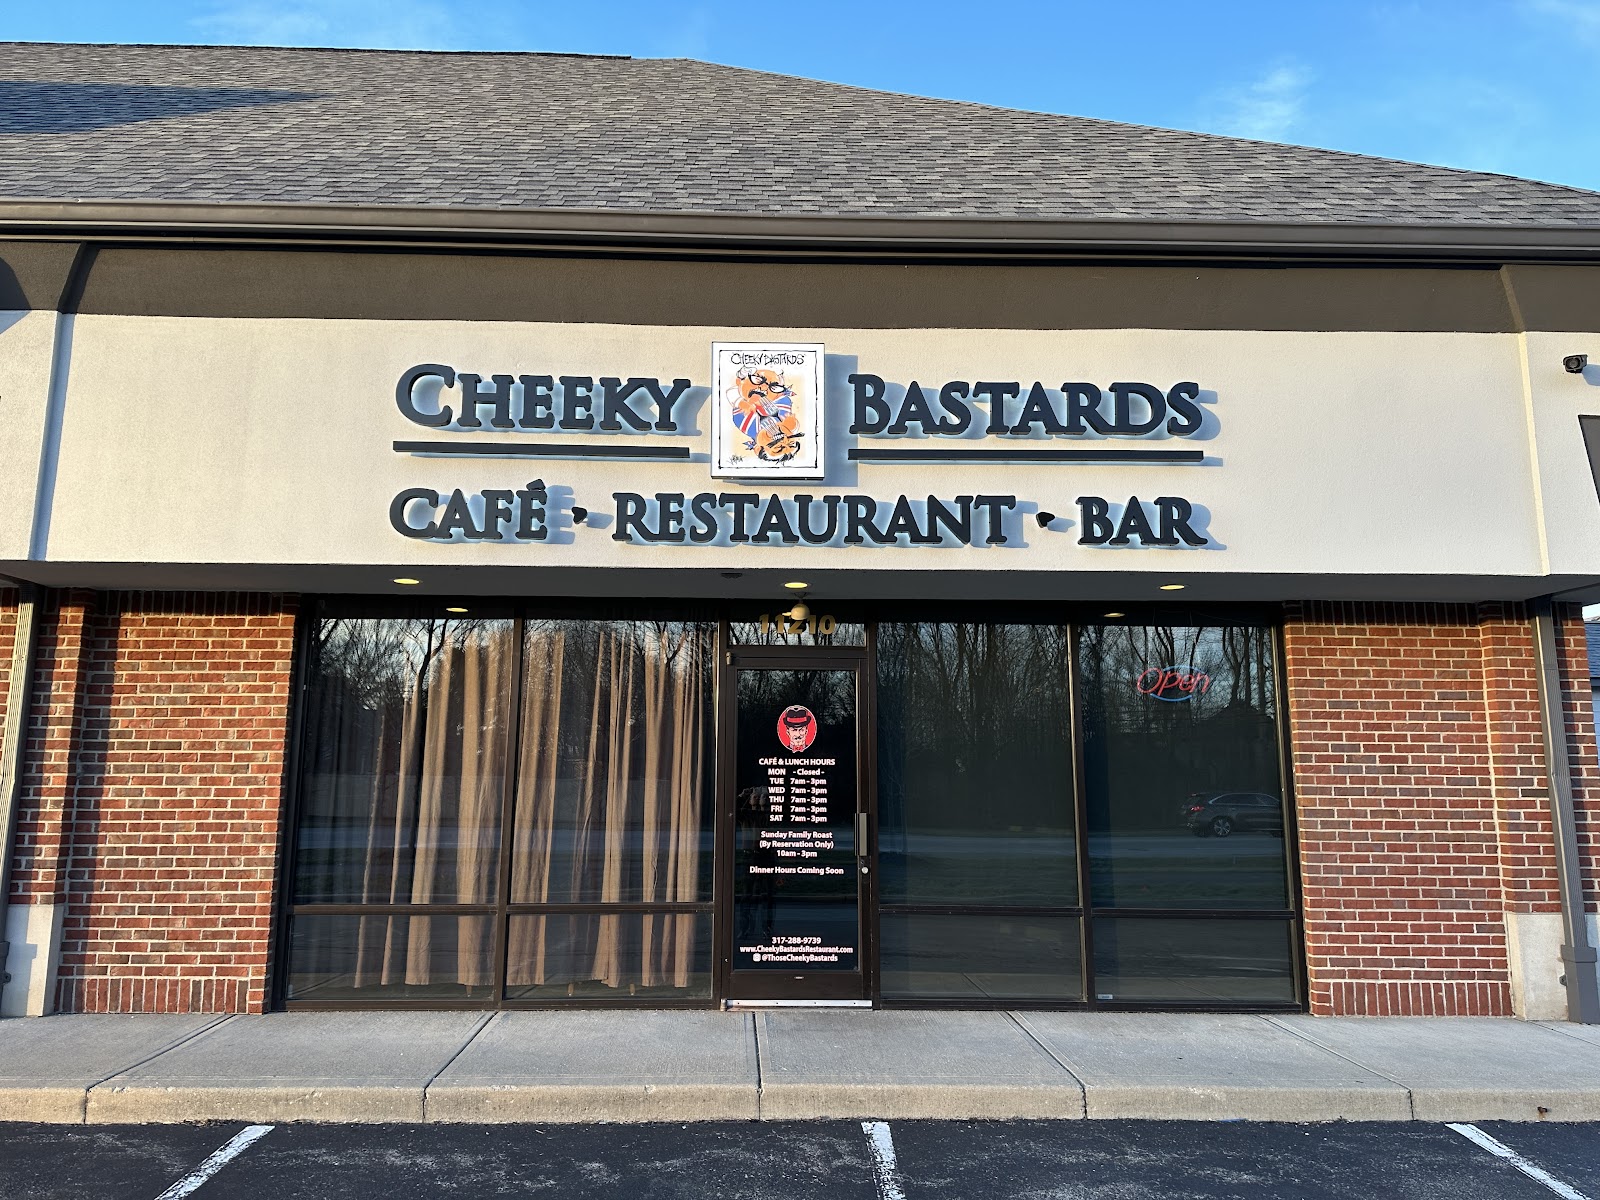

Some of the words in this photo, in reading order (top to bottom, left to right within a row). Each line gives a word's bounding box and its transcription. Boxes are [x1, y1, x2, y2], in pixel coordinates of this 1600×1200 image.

[731, 353, 763, 365] CHEEKY
[395, 363, 692, 432] CHEEKY
[848, 374, 1203, 436] BASTARDS
[389, 478, 548, 540] CAFÉ
[611, 492, 1017, 545] RESTAURANT
[1075, 496, 1209, 546] BAR
[759, 614, 836, 635] 11210
[1136, 667, 1211, 696] Open
[758, 757, 778, 766] CAFÉ
[777, 758, 785, 766] &
[784, 758, 809, 766] LUNCH
[767, 768, 786, 776] MON
[796, 768, 821, 776] Closed
[810, 778, 826, 786] 3pm
[810, 787, 828, 796] 3pm
[810, 796, 828, 805] 3pm
[810, 806, 827, 814] 3pm
[810, 815, 828, 824] 3pm
[760, 831, 788, 839] Sunday
[788, 831, 812, 840] Family
[759, 840, 771, 849] (By
[814, 841, 834, 849] Only)
[800, 850, 818, 858] 3pm
[796, 867, 825, 875] Coming
[739, 945, 854, 954] www.CheekyBastardsRestaurant.com
[761, 953, 838, 963] @ThoseCheekyBastards
